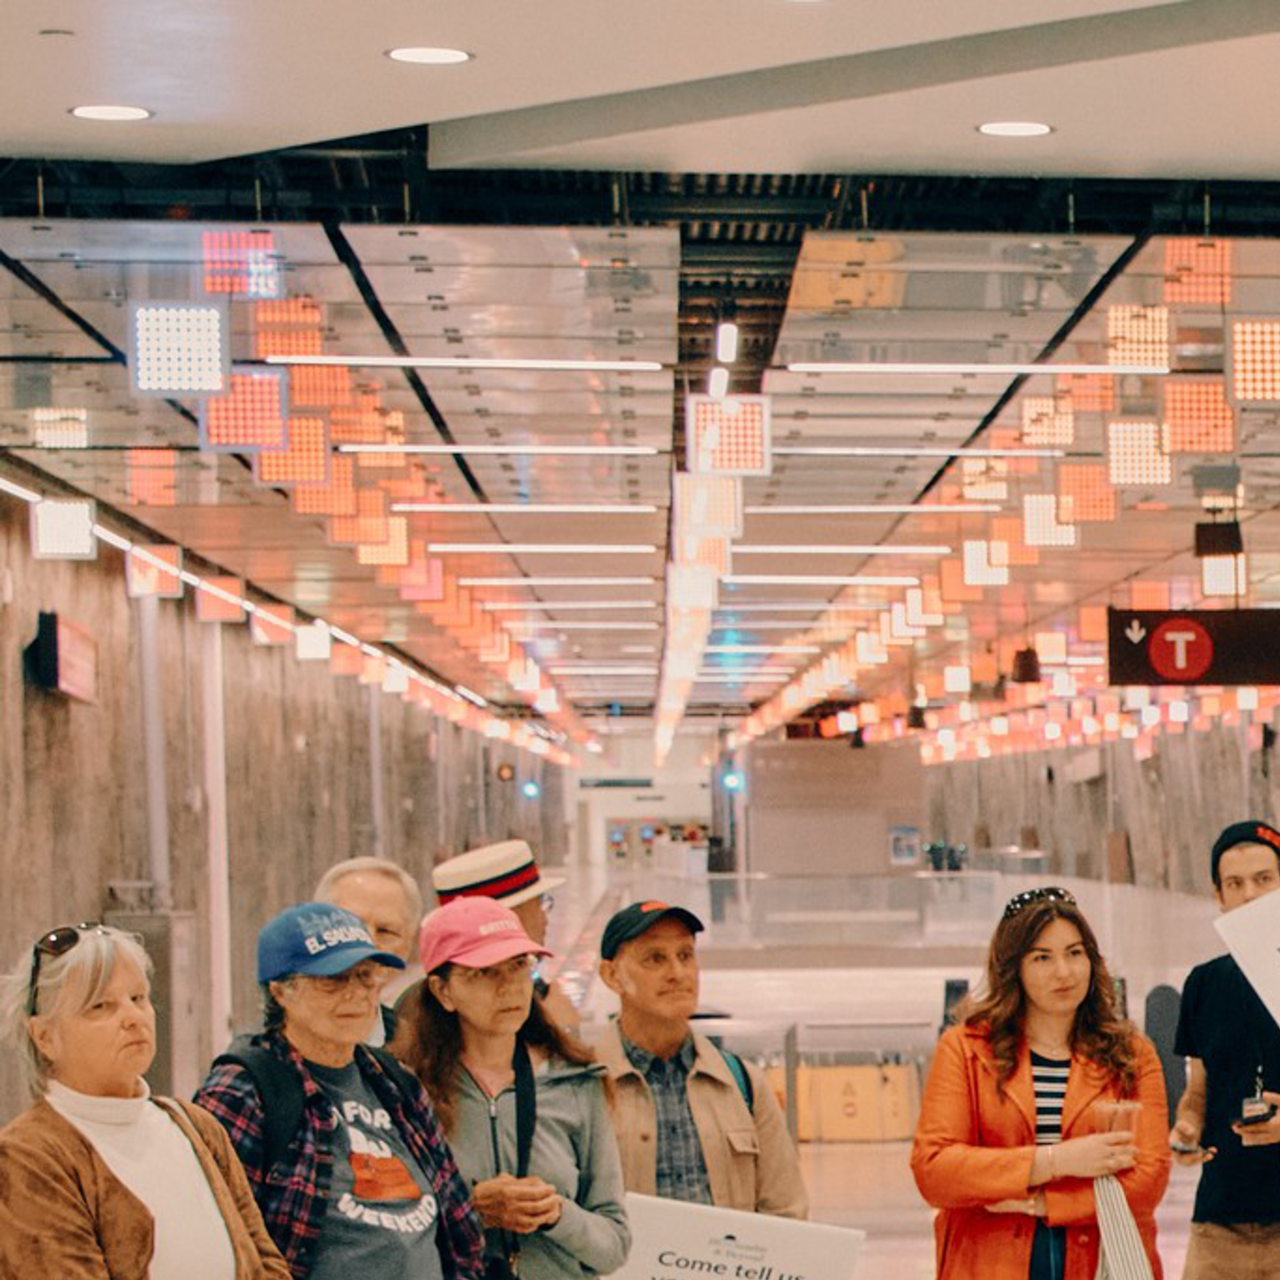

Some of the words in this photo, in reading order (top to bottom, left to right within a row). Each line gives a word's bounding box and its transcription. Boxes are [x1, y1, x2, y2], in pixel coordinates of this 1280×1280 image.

[1164, 631, 1196, 669] T
[337, 1192, 438, 1233] WEEKEND
[658, 1250, 728, 1276] Come
